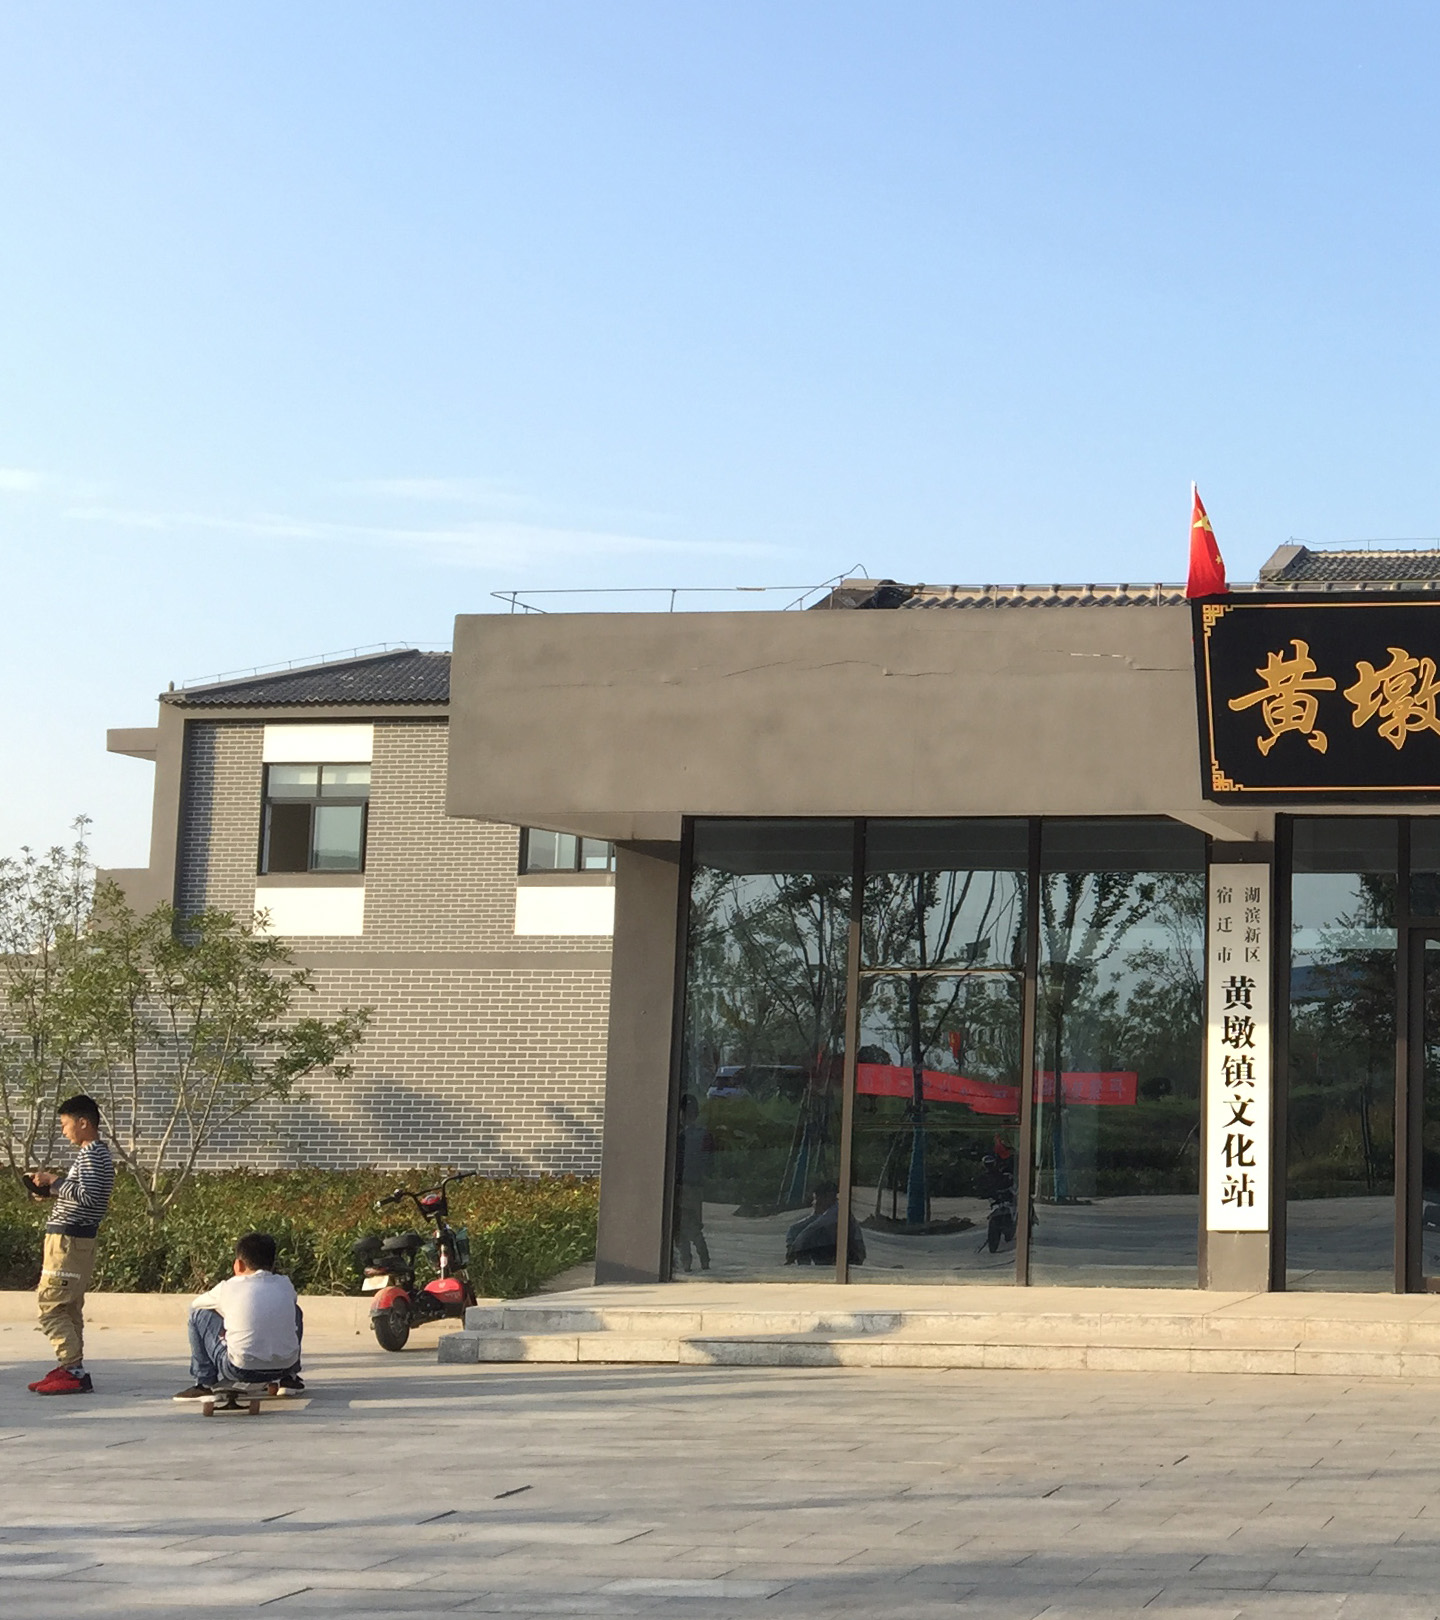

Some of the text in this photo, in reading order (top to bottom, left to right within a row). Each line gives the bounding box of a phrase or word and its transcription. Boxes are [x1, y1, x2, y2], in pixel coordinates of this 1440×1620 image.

[1216, 886, 1233, 964] 宿迁市
[1244, 886, 1261, 962] 湖滨新区
[1221, 975, 1257, 1208] 黄墩镇文化站
